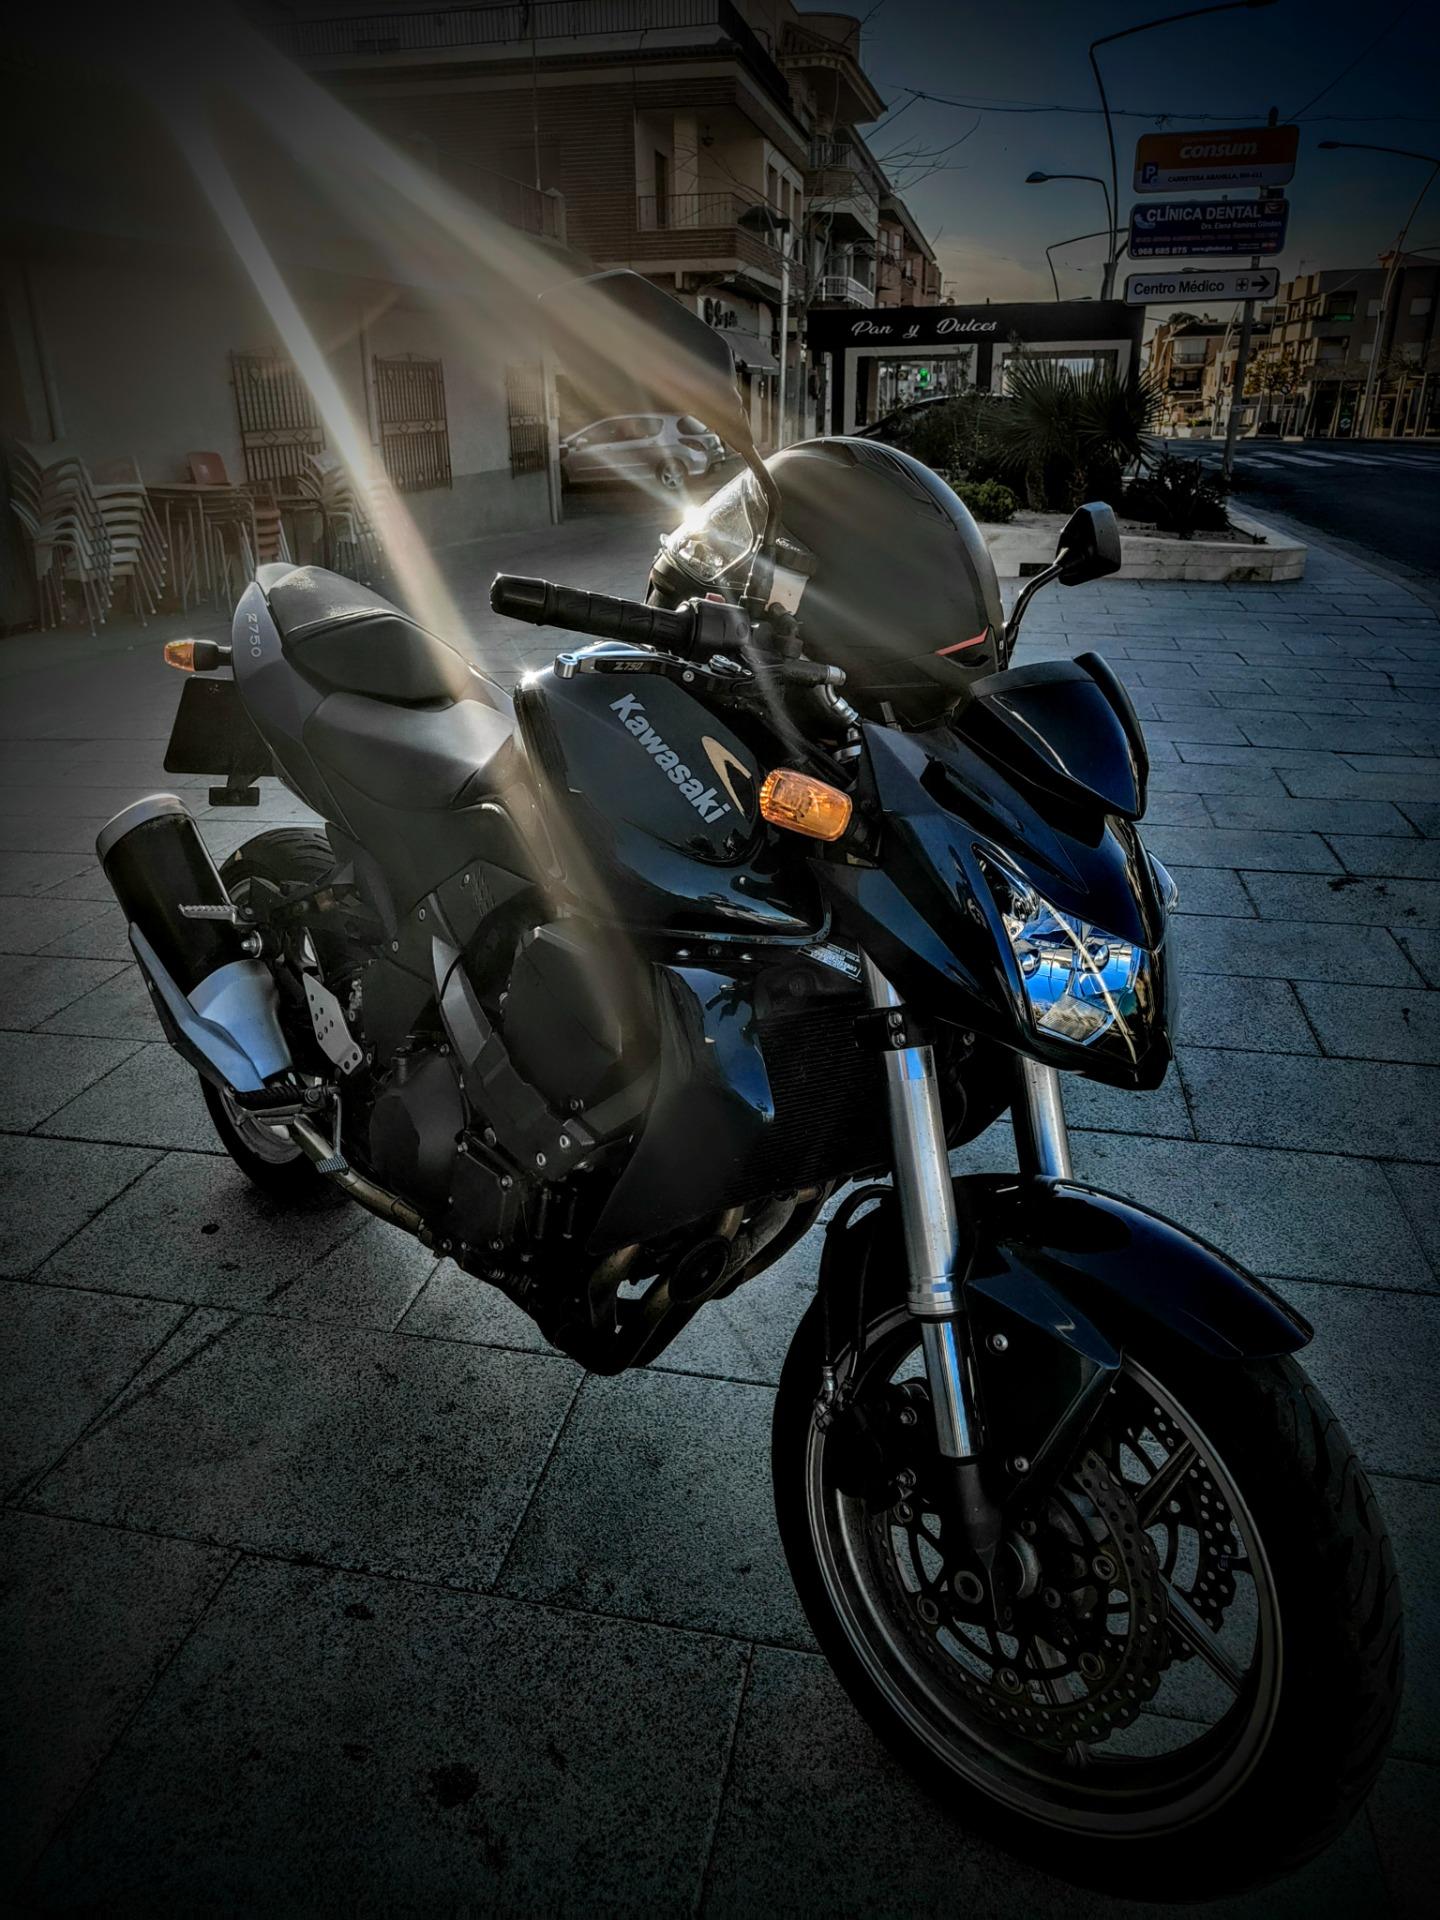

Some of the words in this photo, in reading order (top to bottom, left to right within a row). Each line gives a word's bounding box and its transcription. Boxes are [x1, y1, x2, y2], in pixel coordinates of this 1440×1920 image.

[1179, 142, 1257, 159] consum
[1146, 206, 1202, 222] CLÍNICA
[1205, 205, 1261, 220] DENTAL
[1134, 282, 1175, 295] Centro
[1179, 280, 1224, 293] Médico
[851, 320, 893, 336] Pan
[902, 324, 920, 339] y
[936, 317, 998, 334] Dulces
[246, 613, 262, 657] Z750
[609, 692, 732, 824] Kawasaki
